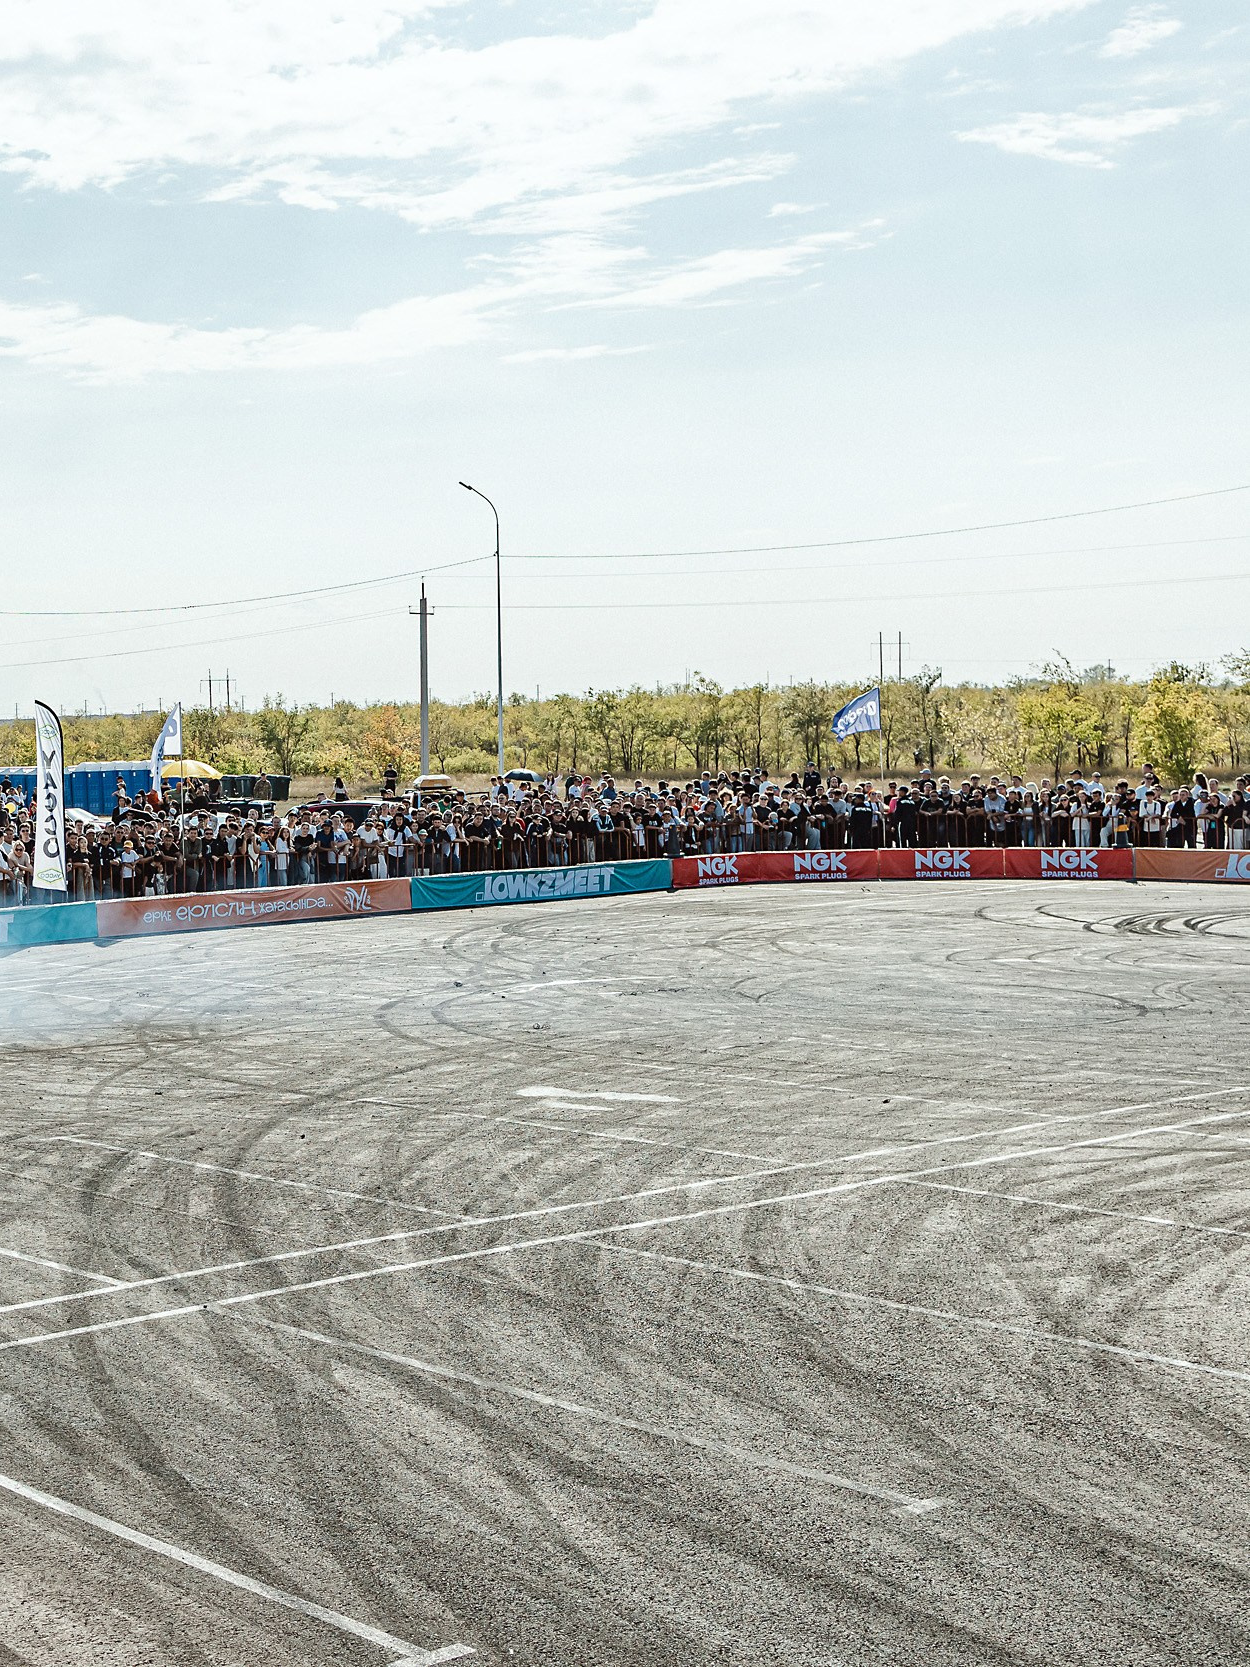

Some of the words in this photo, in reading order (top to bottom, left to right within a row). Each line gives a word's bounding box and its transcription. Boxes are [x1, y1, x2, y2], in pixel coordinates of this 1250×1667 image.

[697, 855, 739, 877] NGK
[793, 852, 848, 872] NGK
[914, 850, 971, 870] NGK
[1040, 850, 1099, 870] NGK
[699, 878, 718, 886] SPARK
[719, 876, 739, 884] PLUGS
